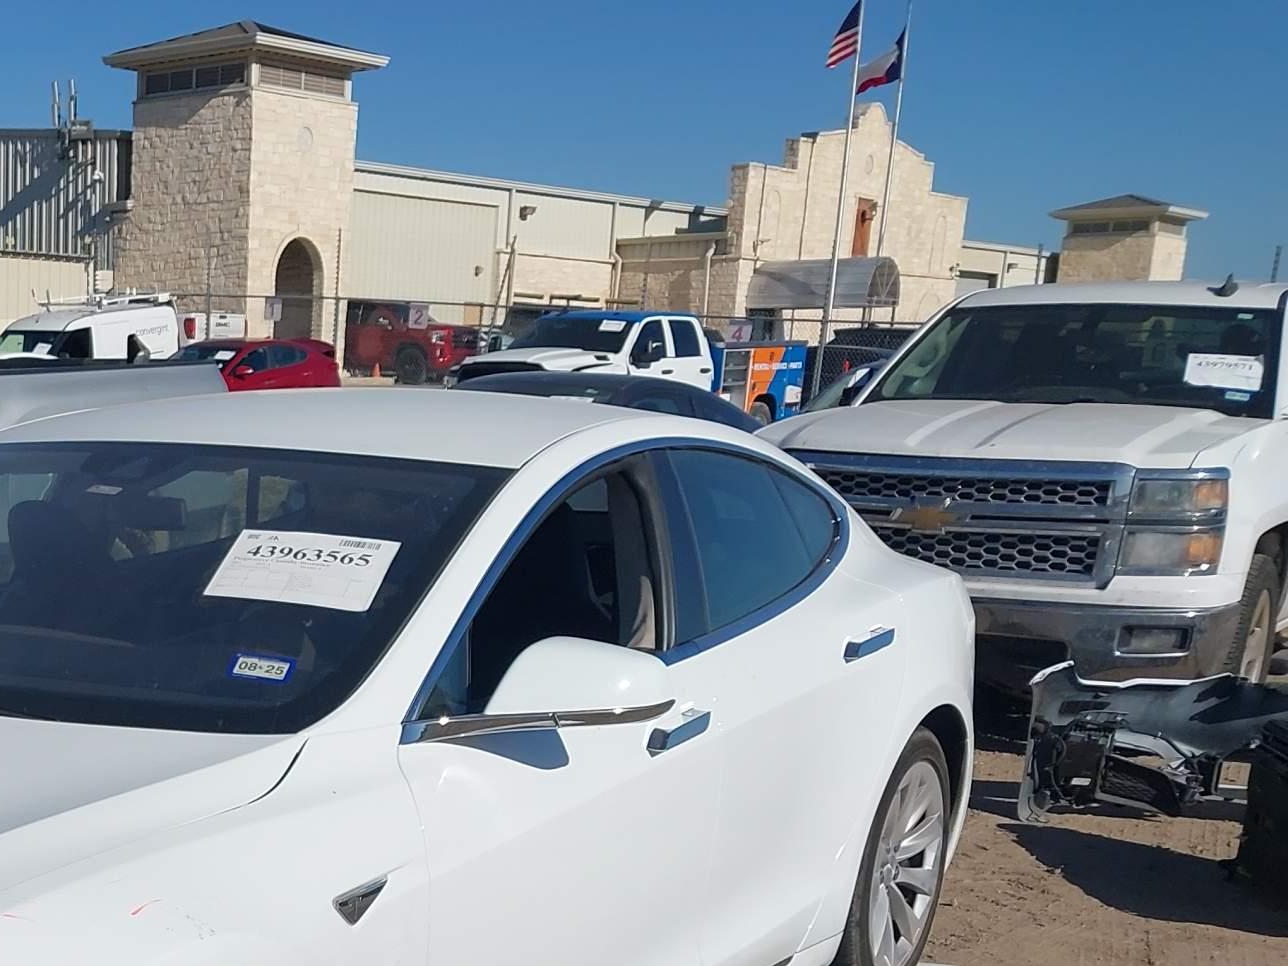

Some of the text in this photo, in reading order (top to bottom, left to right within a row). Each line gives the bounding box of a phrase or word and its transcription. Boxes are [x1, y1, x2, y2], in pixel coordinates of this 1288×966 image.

[414, 309, 424, 325] 2
[732, 325, 744, 341] 4
[247, 544, 373, 568] 43963565
